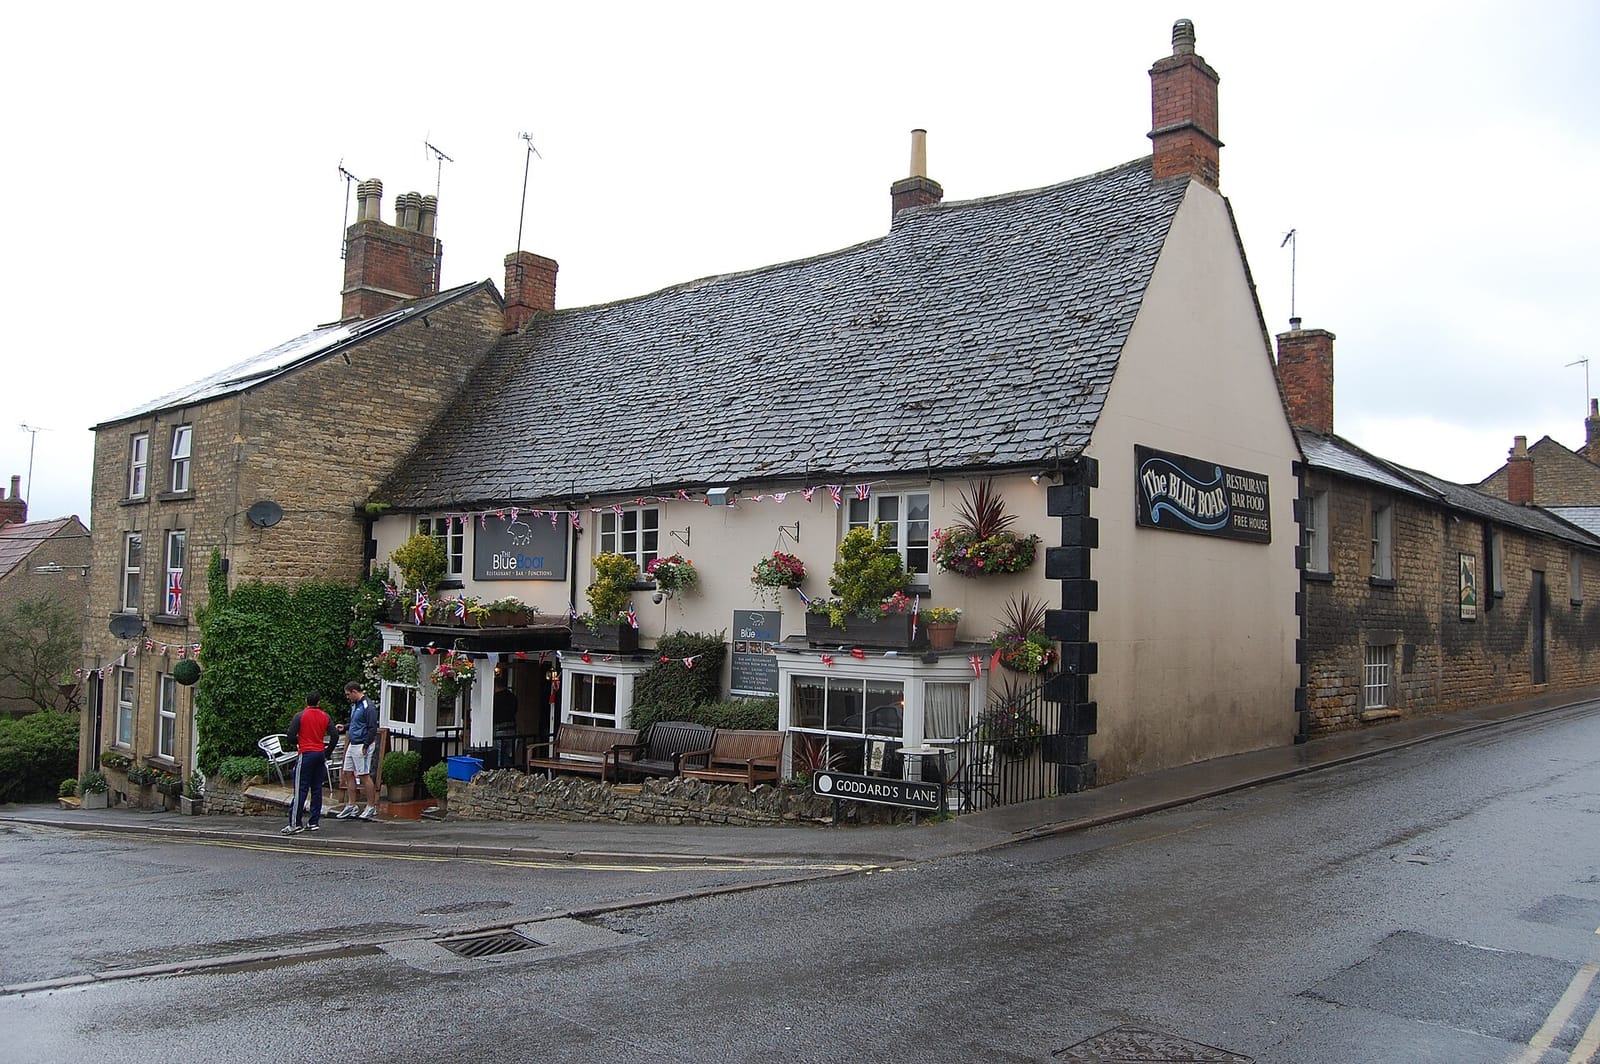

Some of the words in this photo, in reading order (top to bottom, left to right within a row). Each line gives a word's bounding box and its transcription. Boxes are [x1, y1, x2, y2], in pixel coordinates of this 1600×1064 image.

[1143, 467, 1168, 498] The
[1168, 472, 1196, 513] BLUE
[1197, 487, 1228, 516] BOAR
[1226, 473, 1268, 496] RESTAURANT
[1231, 492, 1246, 508] BAR
[1246, 495, 1265, 512] FOOD
[1233, 515, 1249, 528] FREE
[1249, 516, 1268, 531] HOUSE
[836, 779, 899, 798] GODDARD'S
[905, 787, 937, 803] LANE
